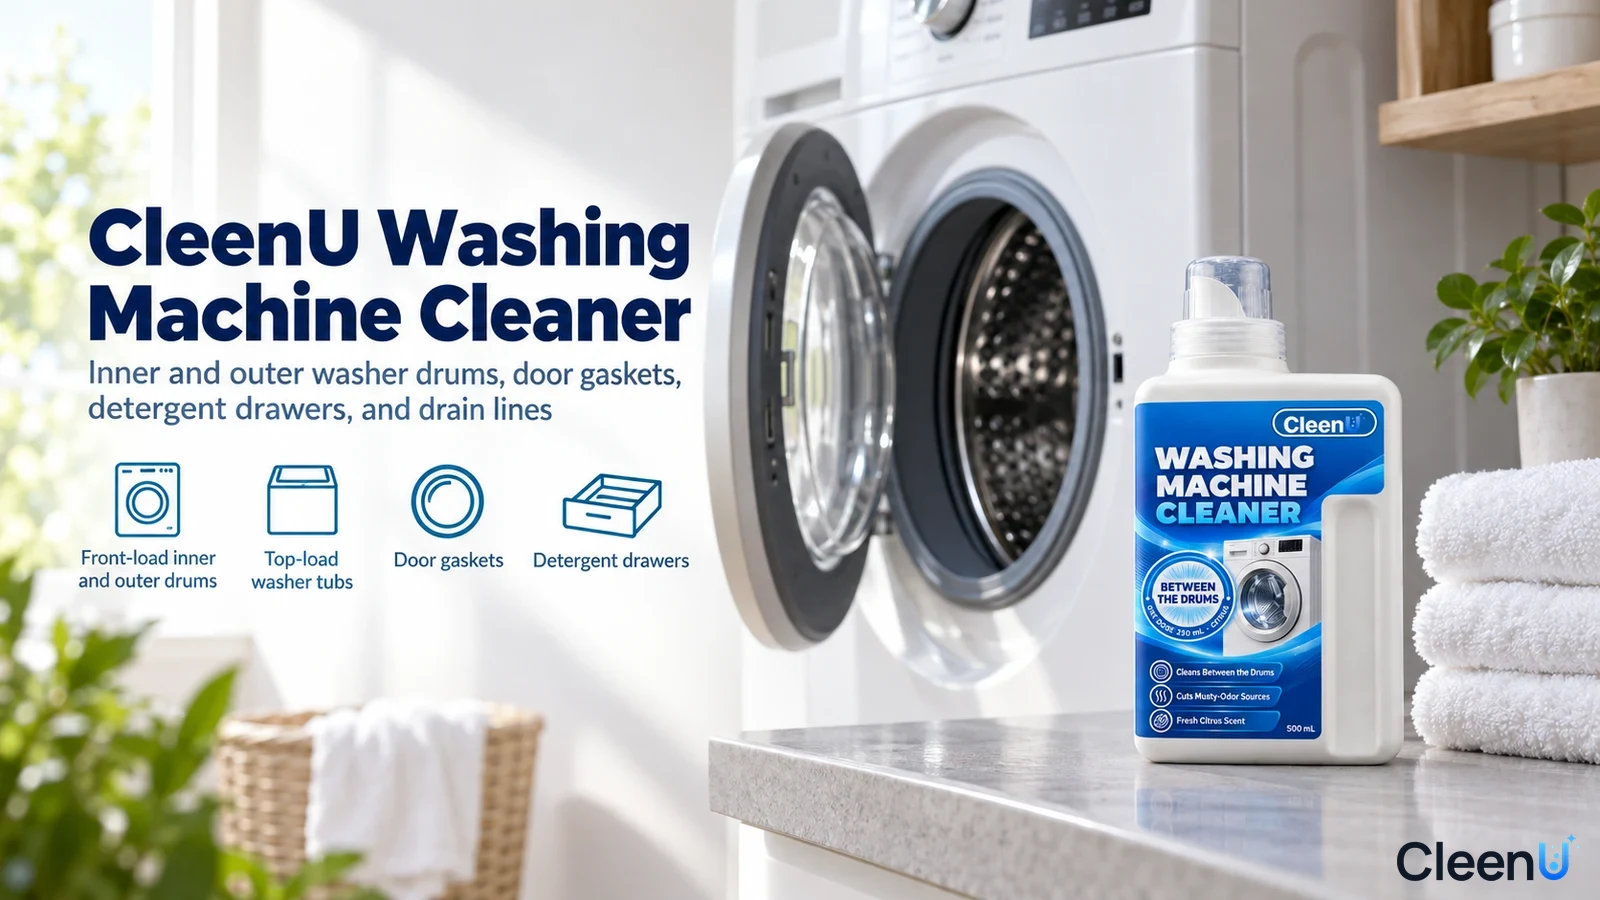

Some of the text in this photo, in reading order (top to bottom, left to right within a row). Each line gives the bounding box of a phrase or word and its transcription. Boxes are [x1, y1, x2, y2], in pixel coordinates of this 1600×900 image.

[1283, 415, 1361, 433] CleenU
[1155, 445, 1314, 469] WASHING
[1157, 474, 1307, 497] MACHINE
[1156, 501, 1301, 524] CLEANER
[1161, 582, 1215, 591] BETWEEN
[1157, 594, 1219, 604] THE DRUMS
[1195, 693, 1239, 701] Musty-Odor
